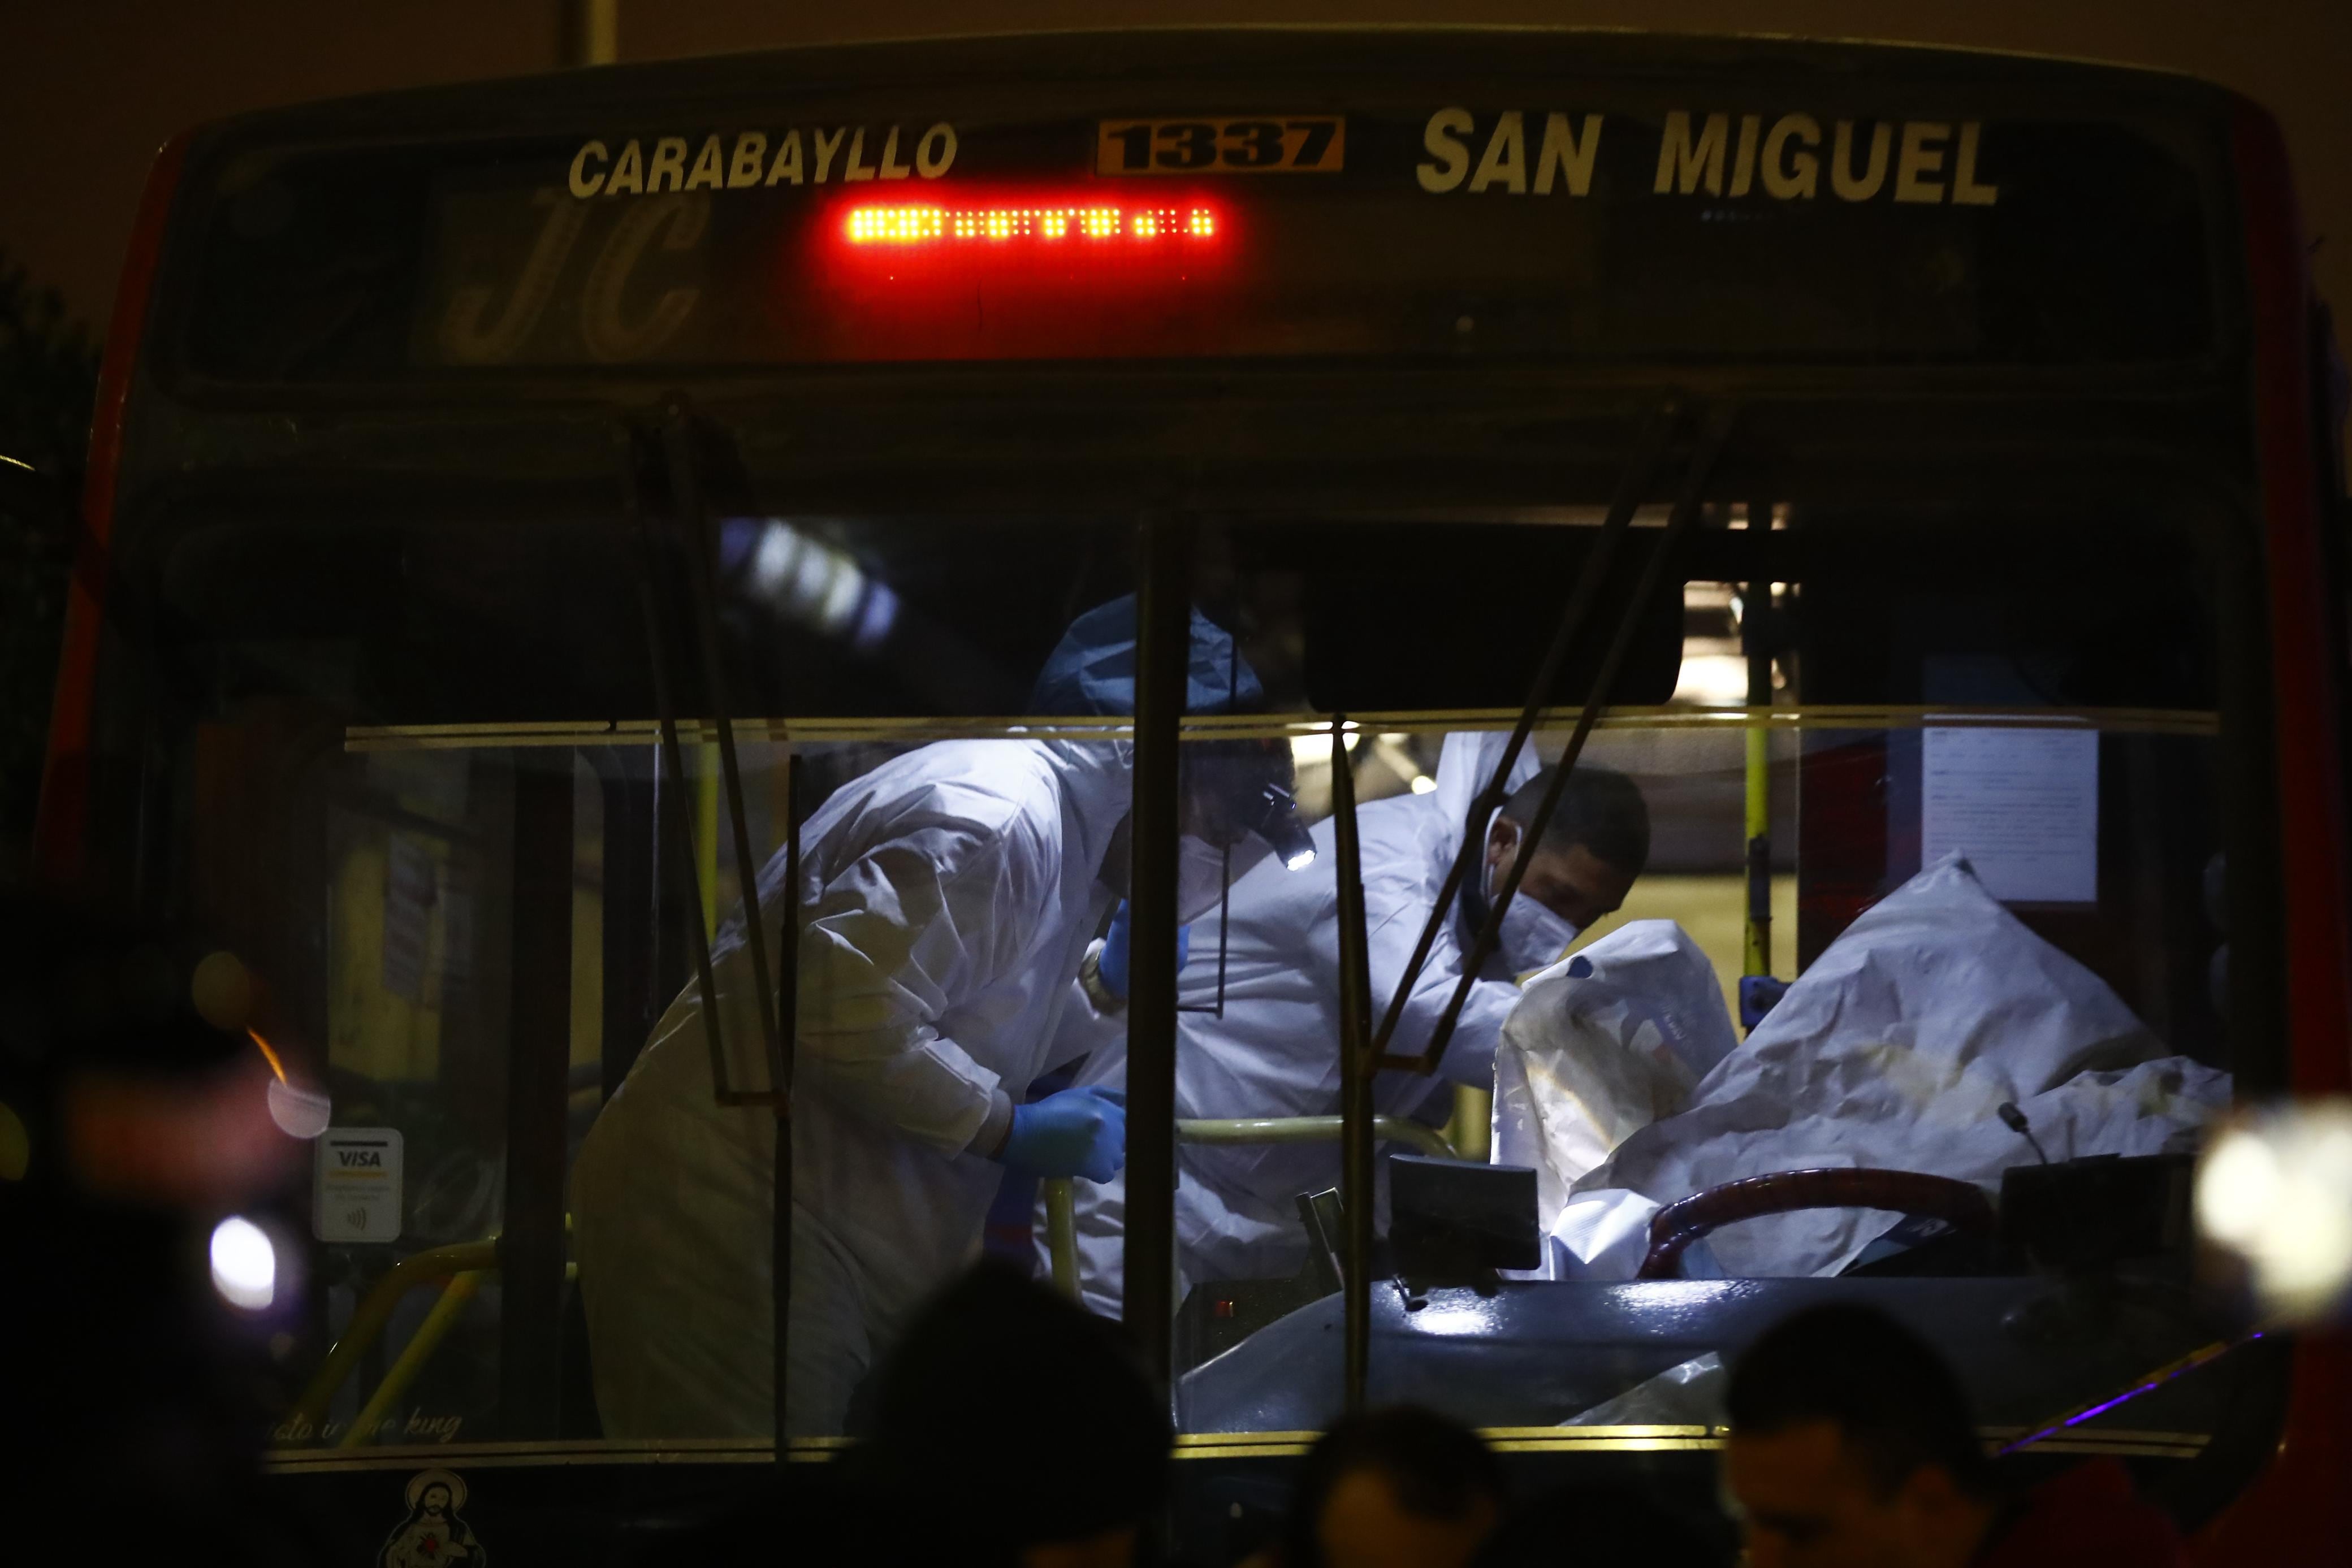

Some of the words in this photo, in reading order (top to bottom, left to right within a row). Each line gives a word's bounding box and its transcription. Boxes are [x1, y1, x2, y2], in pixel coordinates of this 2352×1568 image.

[568, 122, 958, 199] CARABAYLLO
[1107, 122, 1337, 170] 1337
[1415, 107, 1604, 195] SAN
[1653, 110, 1998, 206] MIGUEL
[439, 188, 710, 366] JC
[338, 1151, 382, 1167] VISA
[404, 1406, 462, 1443] king
